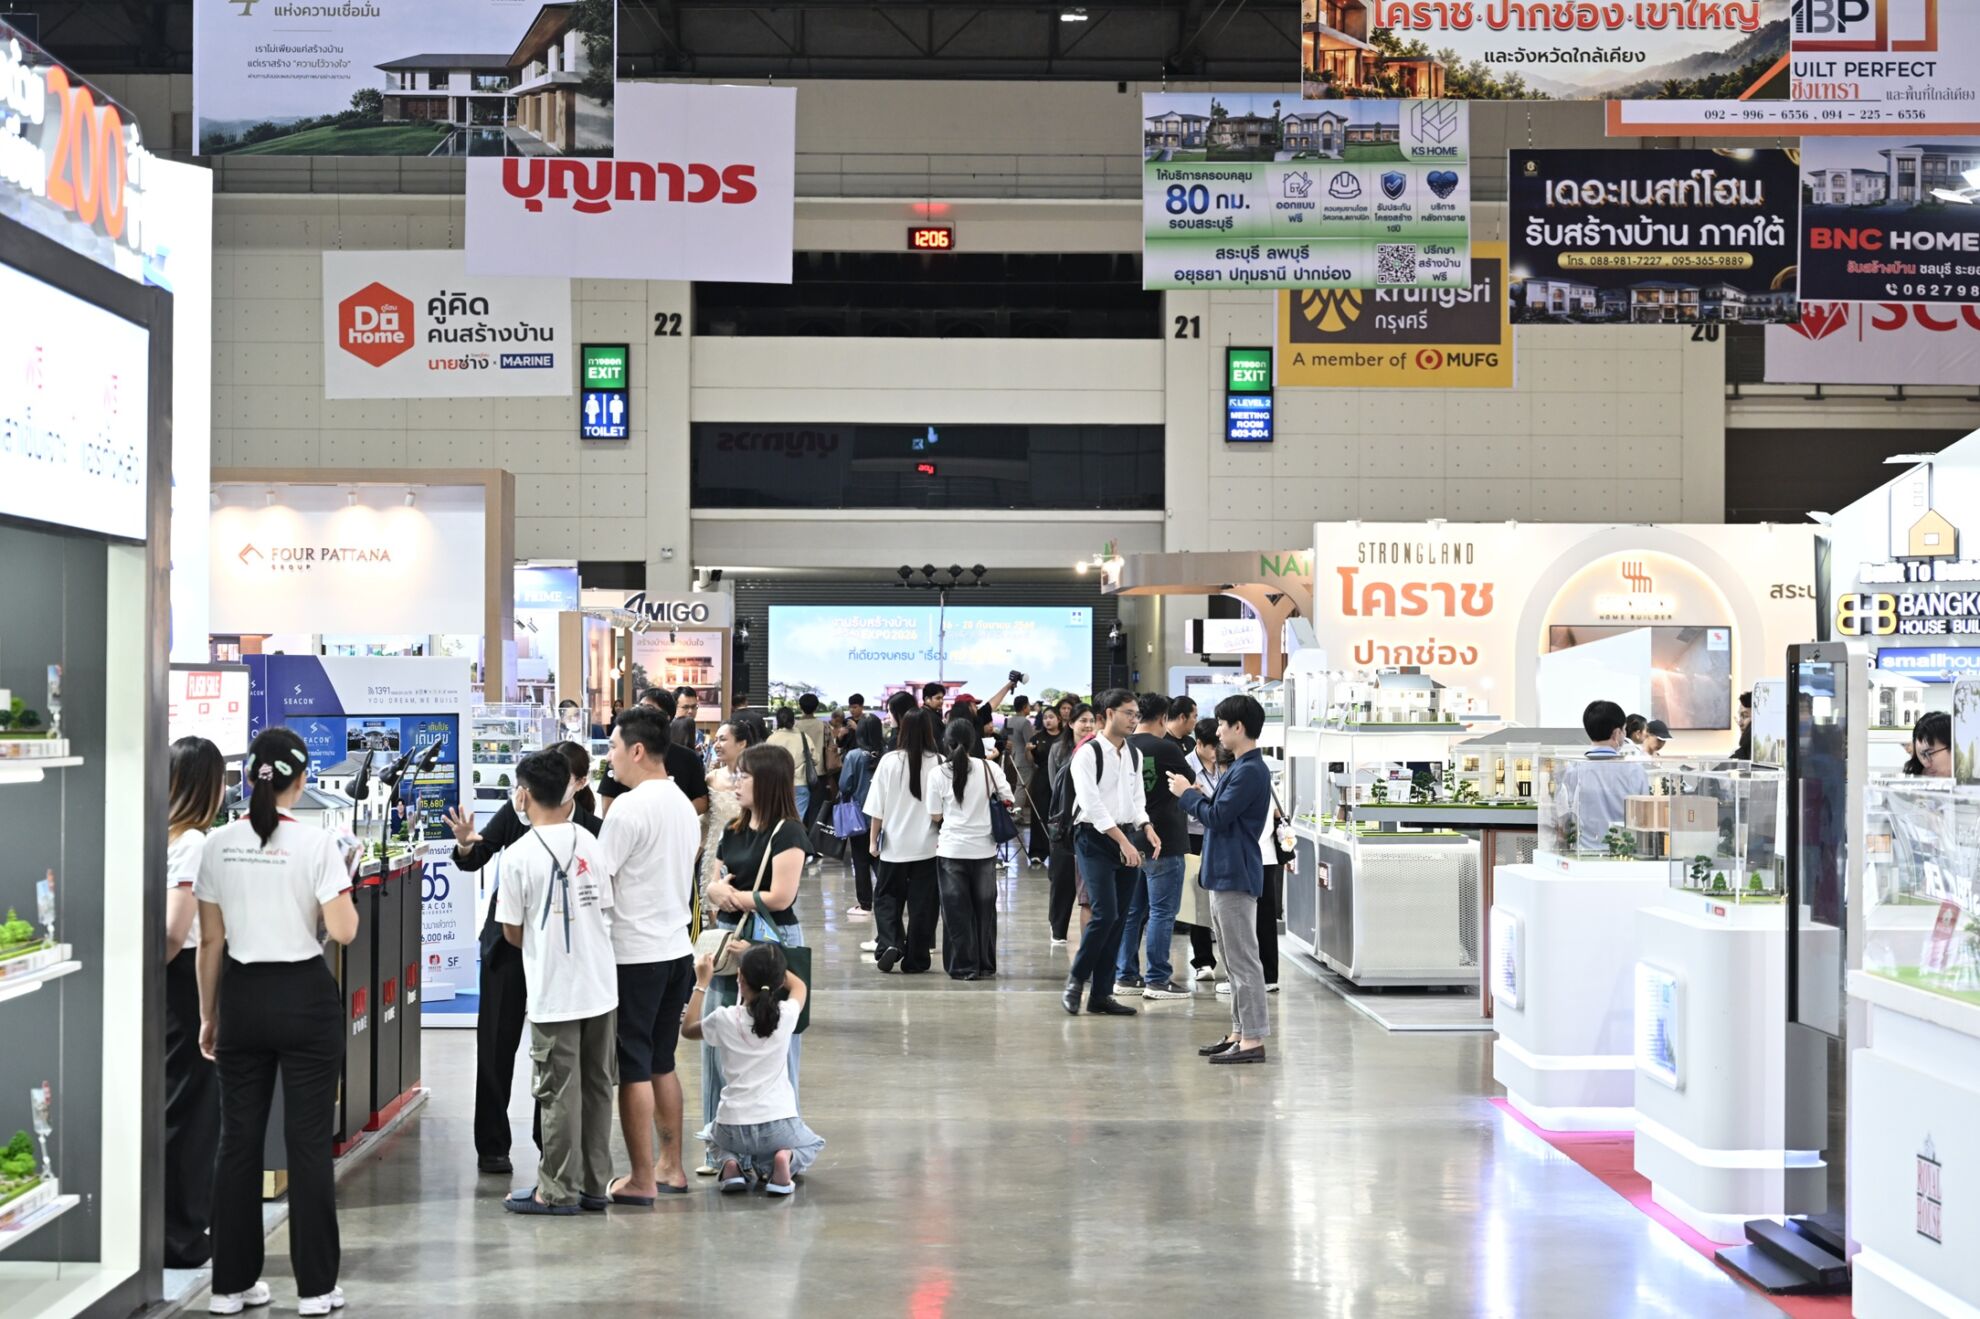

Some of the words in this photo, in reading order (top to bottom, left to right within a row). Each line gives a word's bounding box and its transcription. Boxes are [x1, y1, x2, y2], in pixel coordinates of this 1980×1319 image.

[1486, 0, 1624, 31] ปากชอง
[1484, 46, 1646, 65] และจังหวัดใกล้เคียง
[1844, 61, 1937, 77] PERFECT
[1886, 84, 1975, 101] และพื้นที่ใกล้เคียง
[1704, 110, 1726, 120] 092
[1742, 110, 1764, 120] 996
[1781, 110, 1809, 120] 6556
[1860, 110, 1881, 120] 225
[1898, 110, 1926, 120] 6556
[47, 64, 125, 239] 200
[1411, 147, 1425, 156] KS
[1427, 147, 1458, 156] HOME
[1156, 168, 1252, 183] ให้บริการครอบคลุม
[501, 158, 757, 213] บุญถาวร
[1166, 184, 1210, 215] 80
[1216, 193, 1250, 209] กม.
[1276, 202, 1315, 210] ออกแบบ
[1377, 203, 1411, 211] รับประกัน
[1430, 202, 1456, 211] บริการ
[1169, 216, 1234, 232] รอบสระบุรี
[1288, 213, 1303, 223] ฟรี
[1526, 215, 1688, 246] รับสร้างบ้าน
[1700, 215, 1785, 246] ภาคใต้
[1810, 227, 1883, 250] BNC
[1889, 231, 1980, 251] HOME
[1216, 245, 1260, 263] สระบุรี
[1267, 245, 1310, 263] ลพบุรี
[1423, 244, 1455, 255] ปรึกษา
[1418, 258, 1461, 268] สร้างบ้าน
[1567, 255, 1586, 266] โทร.
[1590, 255, 1662, 266] 088-981-7227
[1672, 255, 1744, 266] 095-365-9889
[1174, 269, 1222, 285] อยุธยา
[1230, 266, 1286, 285] ปทุมธานี
[1294, 266, 1351, 281] ปากช่อง
[1432, 271, 1448, 281] ฟรี
[1847, 260, 1916, 275] รับสร้างบ้าน
[1920, 262, 1951, 278] ชลบุรี
[427, 290, 489, 324] คู่คิด
[654, 312, 682, 336] 22
[1175, 315, 1200, 339] 21
[1375, 312, 1429, 334] กรุงศรี
[348, 328, 405, 344] home
[428, 322, 554, 343] คนสร้างบ้าน
[428, 355, 489, 370] นายช่าง
[502, 355, 552, 367] MARINE
[1292, 352, 1306, 366] A
[1311, 352, 1384, 367] member
[1389, 351, 1407, 367] of
[1447, 353, 1499, 367] MUFG
[588, 367, 622, 379] EXIT
[1233, 370, 1267, 382] EXIT
[584, 426, 625, 437] TOILET
[271, 548, 315, 561] FOUR
[320, 548, 391, 562] PATTANA
[1358, 542, 1474, 564] STRONGLAND
[1907, 561, 1932, 582] To
[1337, 567, 1494, 617] โคราช
[624, 592, 709, 622] AMIGO
[1899, 592, 1980, 616] BANGK
[1900, 620, 1947, 634] HOUSE
[1354, 638, 1478, 665] ปากช่อง
[447, 957, 459, 967] SF
